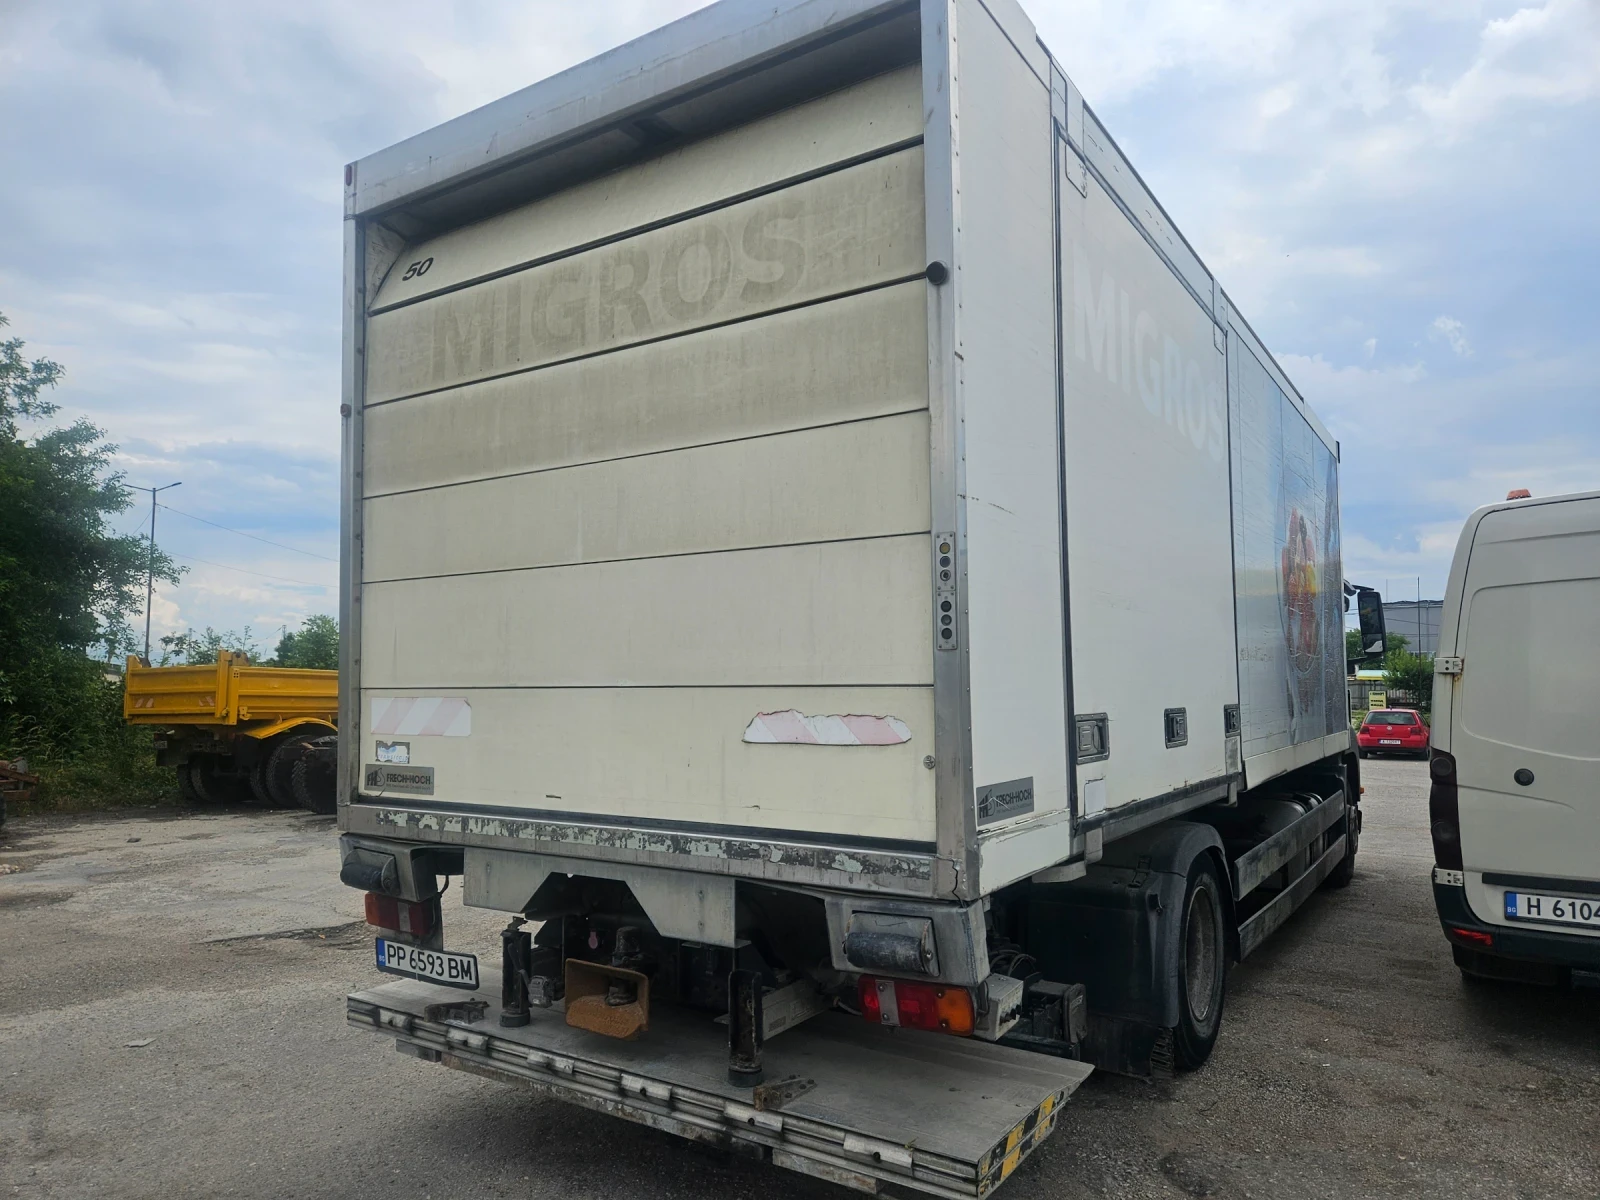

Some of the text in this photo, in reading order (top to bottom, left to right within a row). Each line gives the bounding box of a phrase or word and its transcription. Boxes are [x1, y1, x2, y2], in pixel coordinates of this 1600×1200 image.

[402, 257, 434, 281] 50
[432, 197, 808, 383] MIGROS
[1073, 239, 1225, 463] MIGROS
[386, 773, 431, 785] FRECH-HOCH
[1527, 897, 1541, 916] H
[386, 944, 406, 967] PP
[409, 949, 445, 977] 6593
[448, 957, 473, 981] BM
